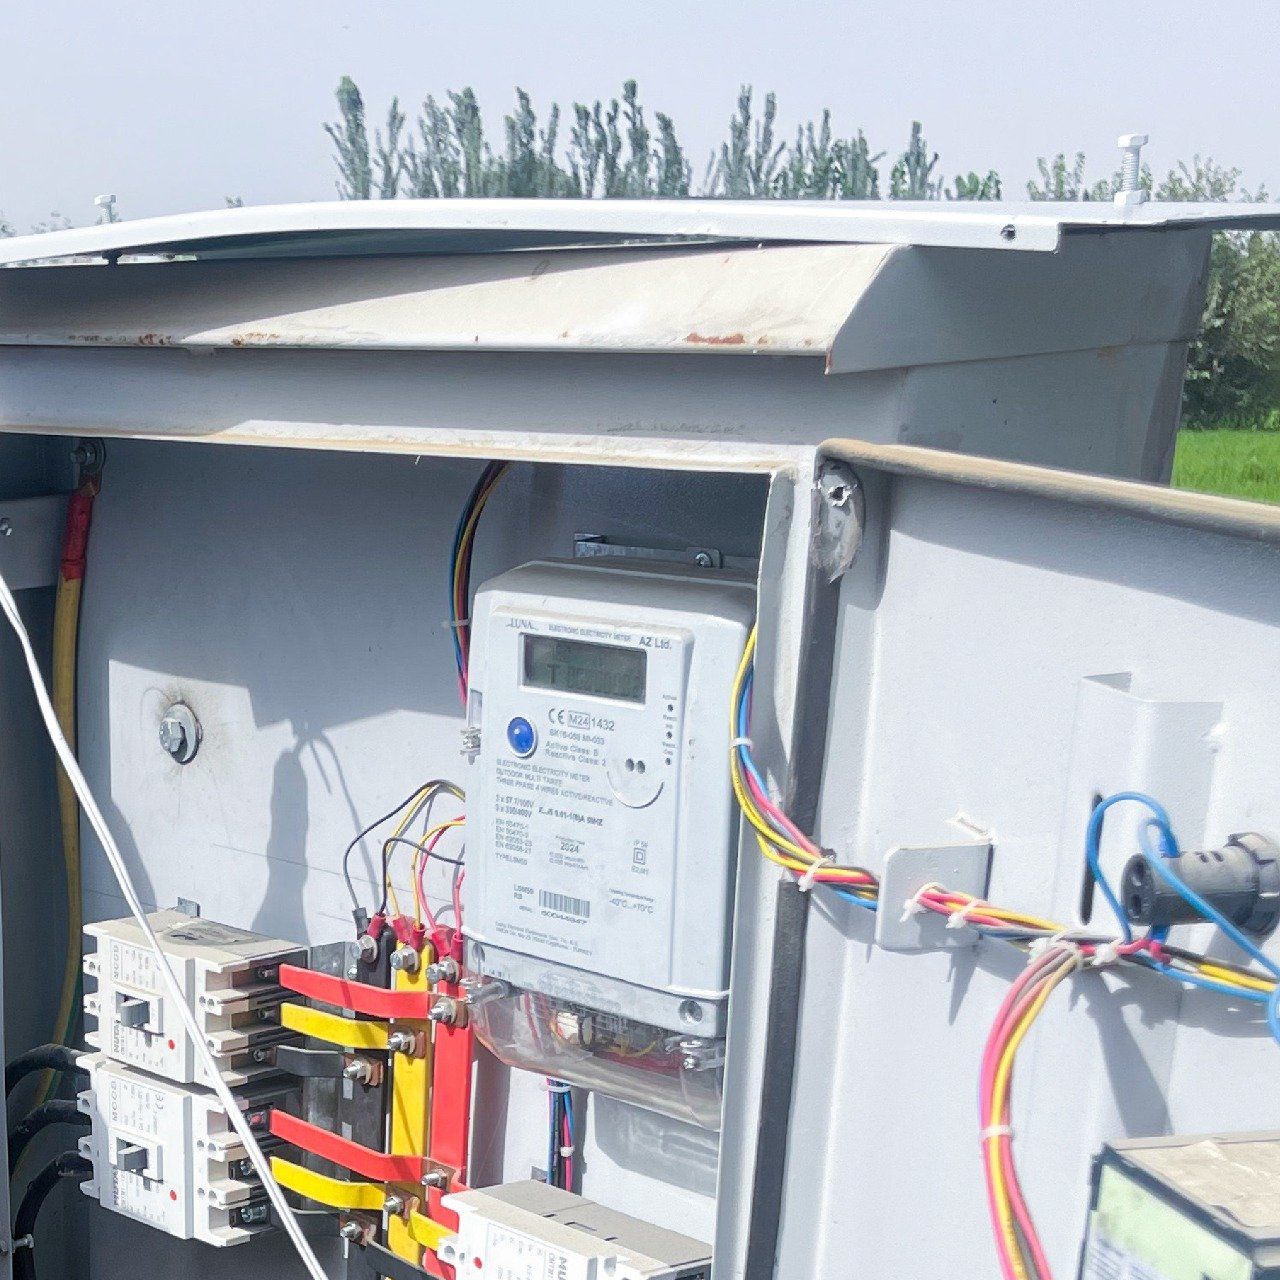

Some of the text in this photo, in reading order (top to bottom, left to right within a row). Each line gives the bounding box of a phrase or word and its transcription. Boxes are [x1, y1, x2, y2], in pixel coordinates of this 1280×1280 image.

[639, 637, 672, 650] AZ Ltd.
[591, 717, 615, 732] 1432
[561, 841, 579, 853] 2024
